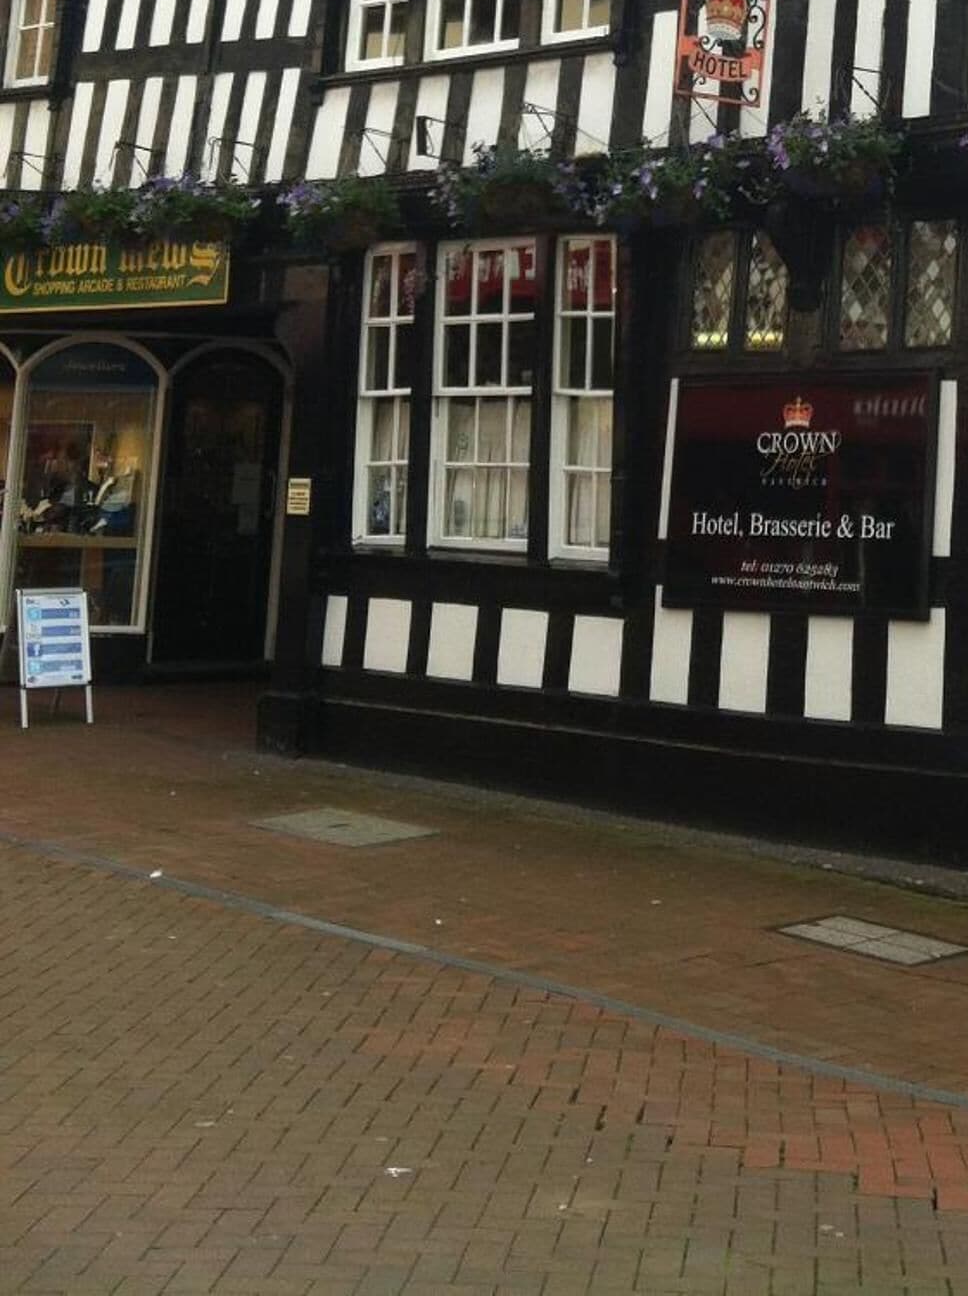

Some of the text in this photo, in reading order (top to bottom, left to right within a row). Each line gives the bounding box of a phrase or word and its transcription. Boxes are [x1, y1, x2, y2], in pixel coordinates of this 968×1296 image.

[693, 50, 747, 79] HOTEL
[77, 278, 115, 293] ARCADE
[115, 280, 124, 292] &
[125, 275, 186, 292] RESTAURANT
[756, 432, 838, 454] CROWN
[691, 512, 896, 540] Hotel, Brasserie & Bar
[740, 560, 758, 574] tel:
[760, 562, 794, 574] 01270
